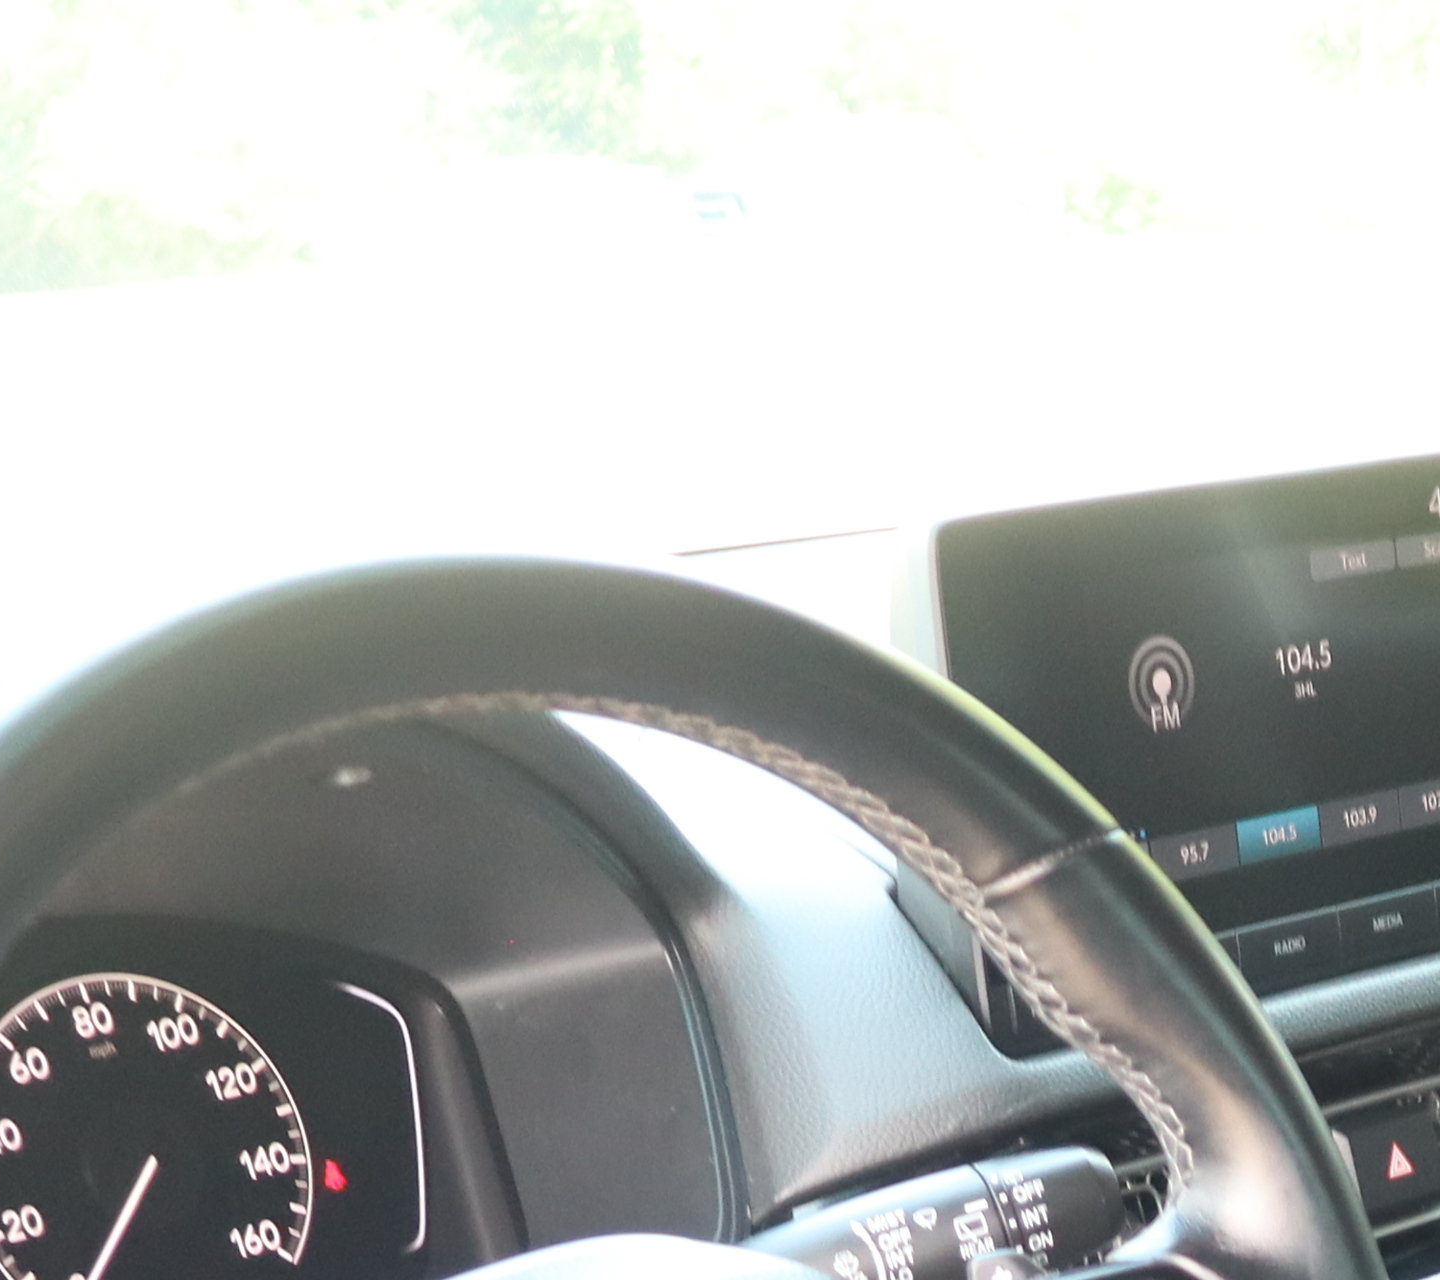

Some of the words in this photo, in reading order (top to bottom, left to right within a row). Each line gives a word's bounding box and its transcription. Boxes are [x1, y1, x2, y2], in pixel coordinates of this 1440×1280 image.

[1340, 552, 1368, 572] Text
[1275, 638, 1332, 676] 104.5
[1150, 701, 1182, 733] FM
[1342, 807, 1377, 829] 103.9
[1262, 824, 1297, 847] 104.5
[1180, 841, 1209, 865] 95.7
[1372, 913, 1403, 933] MEDIA
[1273, 936, 1306, 957] RADIO
[72, 1001, 114, 1039] 80
[146, 1013, 199, 1052] 100
[9, 1046, 50, 1085] 60
[206, 1062, 257, 1101] 120
[239, 1141, 291, 1181] 140
[1012, 1177, 1046, 1204] OFF
[1, 1204, 45, 1243] 20
[1021, 1203, 1049, 1230] INT
[229, 1218, 281, 1259] 160
[877, 1226, 913, 1252] OFF
[1028, 1228, 1055, 1253] ON
[885, 1245, 914, 1271] INT
